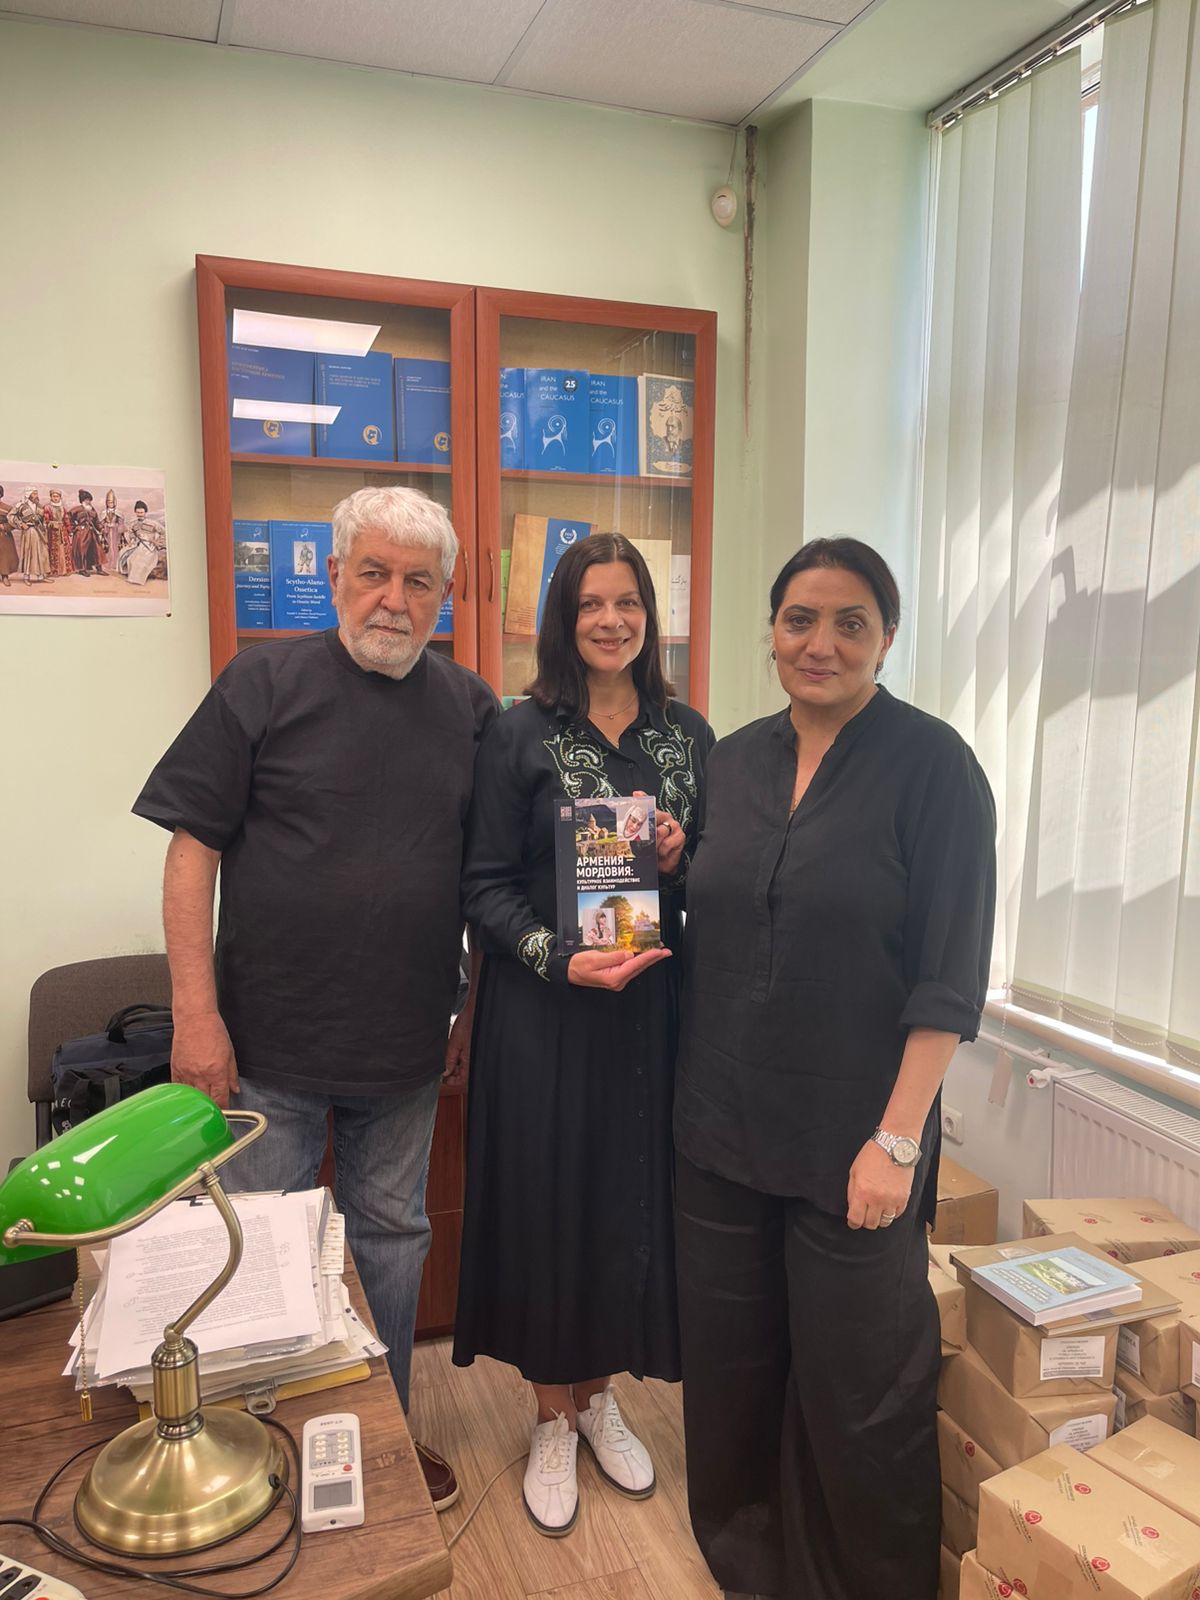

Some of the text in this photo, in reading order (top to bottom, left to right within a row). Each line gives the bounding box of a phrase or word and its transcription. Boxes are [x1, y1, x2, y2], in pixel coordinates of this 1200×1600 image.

[565, 380, 576, 389] 25
[499, 391, 525, 399] UCASUS
[540, 393, 575, 401] CAUCASUS
[590, 397, 624, 405] CAUCASUS
[576, 855, 624, 867] АРМЕНИЯ
[576, 866, 634, 878] МОРДОВИЯ:
